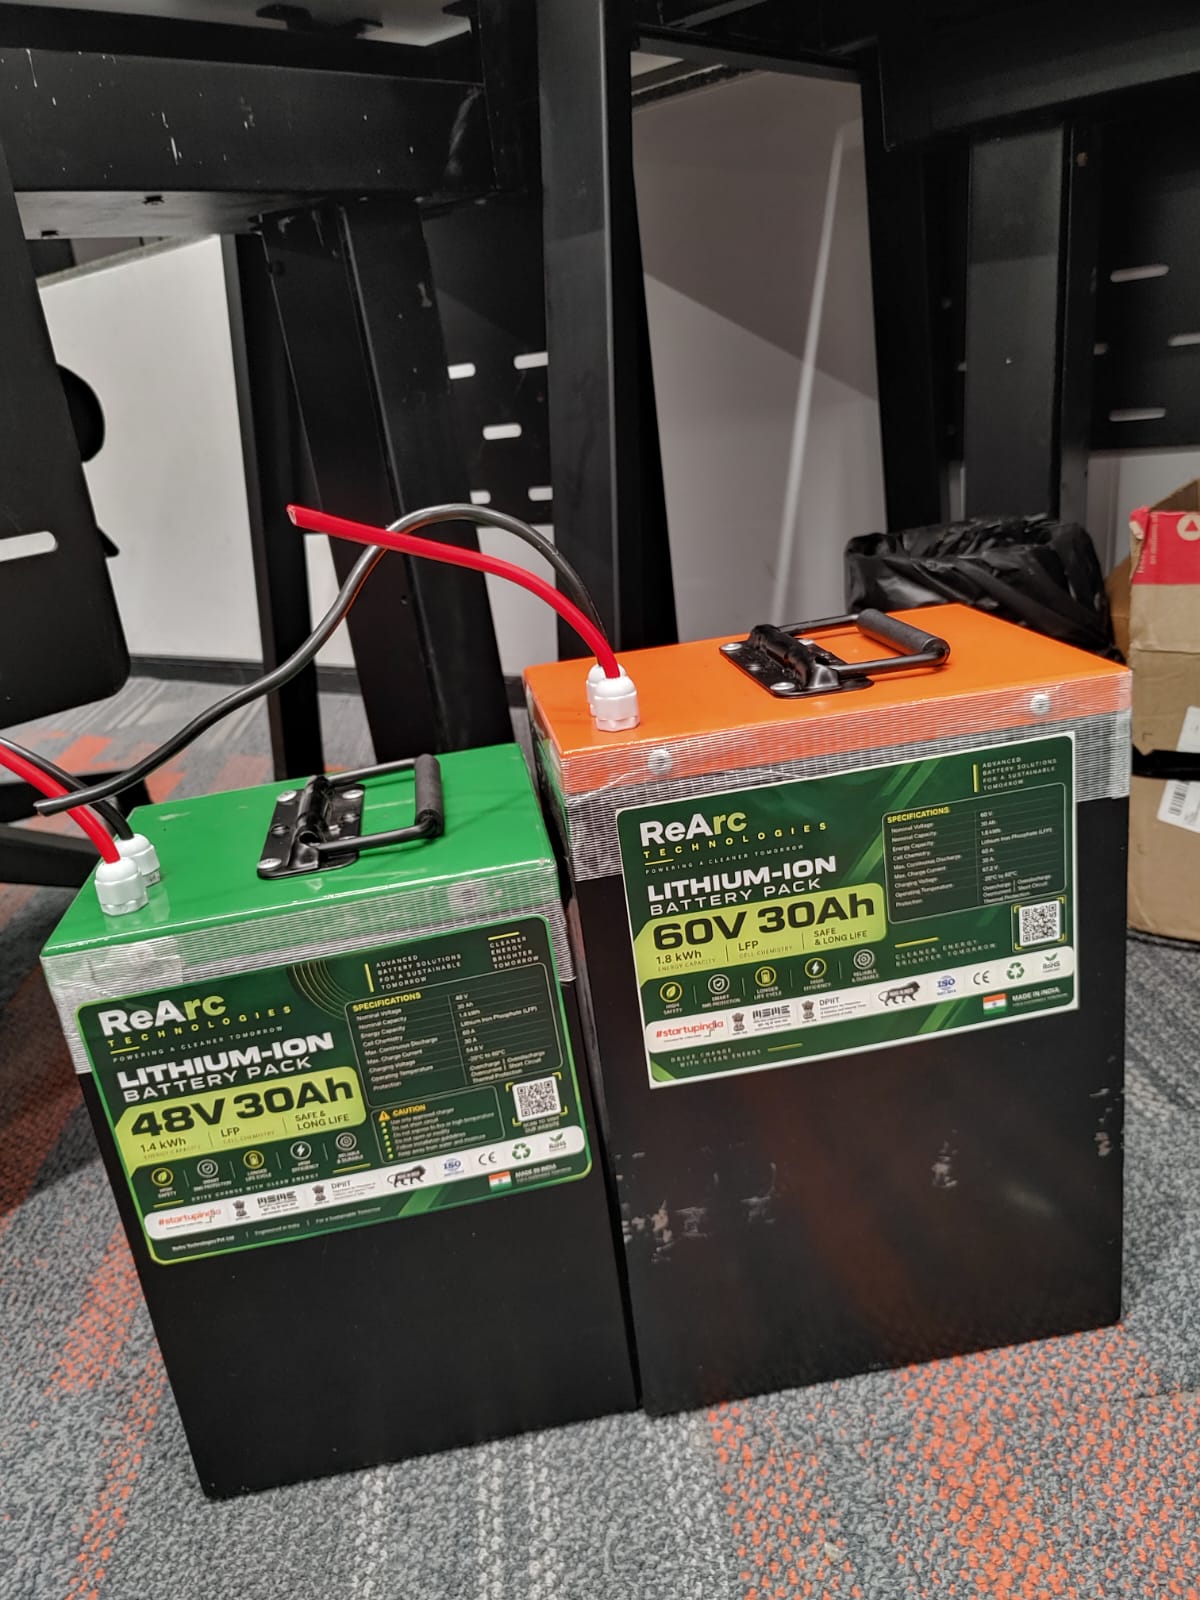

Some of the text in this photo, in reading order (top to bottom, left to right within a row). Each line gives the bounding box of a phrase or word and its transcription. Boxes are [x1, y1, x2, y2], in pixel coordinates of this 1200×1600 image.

[887, 806, 949, 823] SPECIFICATIONS
[639, 812, 746, 846] ReArc
[643, 822, 826, 858] TECHNOLOGIES
[645, 862, 692, 874] POWERING
[708, 853, 748, 864] CLEANER
[754, 844, 803, 856] TOMORROW
[647, 855, 836, 901] LITHIUM-ION
[650, 877, 820, 915] BATTERY PACK
[653, 893, 874, 950] 60V 30Ah
[813, 927, 836, 937] SAFE
[823, 933, 847, 944] LONG
[850, 930, 867, 940] LIFE
[738, 940, 758, 951] LFP
[375, 955, 418, 967] ADVANCED
[377, 953, 461, 975] BATTERY SOLUTIONS
[656, 949, 701, 964] 1.8 kWh
[937, 978, 955, 987] ISO
[973, 970, 989, 985] CE
[352, 992, 421, 1012] SPECIFICATIONS
[819, 996, 839, 1006] DPIIT
[98, 995, 225, 1036] ReArc
[107, 1005, 290, 1047] TECHNOLOGIES
[655, 1019, 723, 1038] #startupindia
[112, 1048, 164, 1062] POWERING
[180, 1036, 223, 1050] CLEANER
[229, 1025, 282, 1040] TOMORROW
[117, 1032, 333, 1088] LITHIUM-ION
[123, 1056, 311, 1102] BATTERY PACK
[131, 1077, 352, 1136] 48V 30Ah
[392, 1103, 426, 1116] CAUTION
[294, 1111, 317, 1121] SAFE
[296, 1113, 349, 1130] LONG LIFE
[220, 1126, 240, 1137] LFP
[140, 1137, 186, 1152] 1.4 kWh
[443, 1160, 461, 1169] ISO
